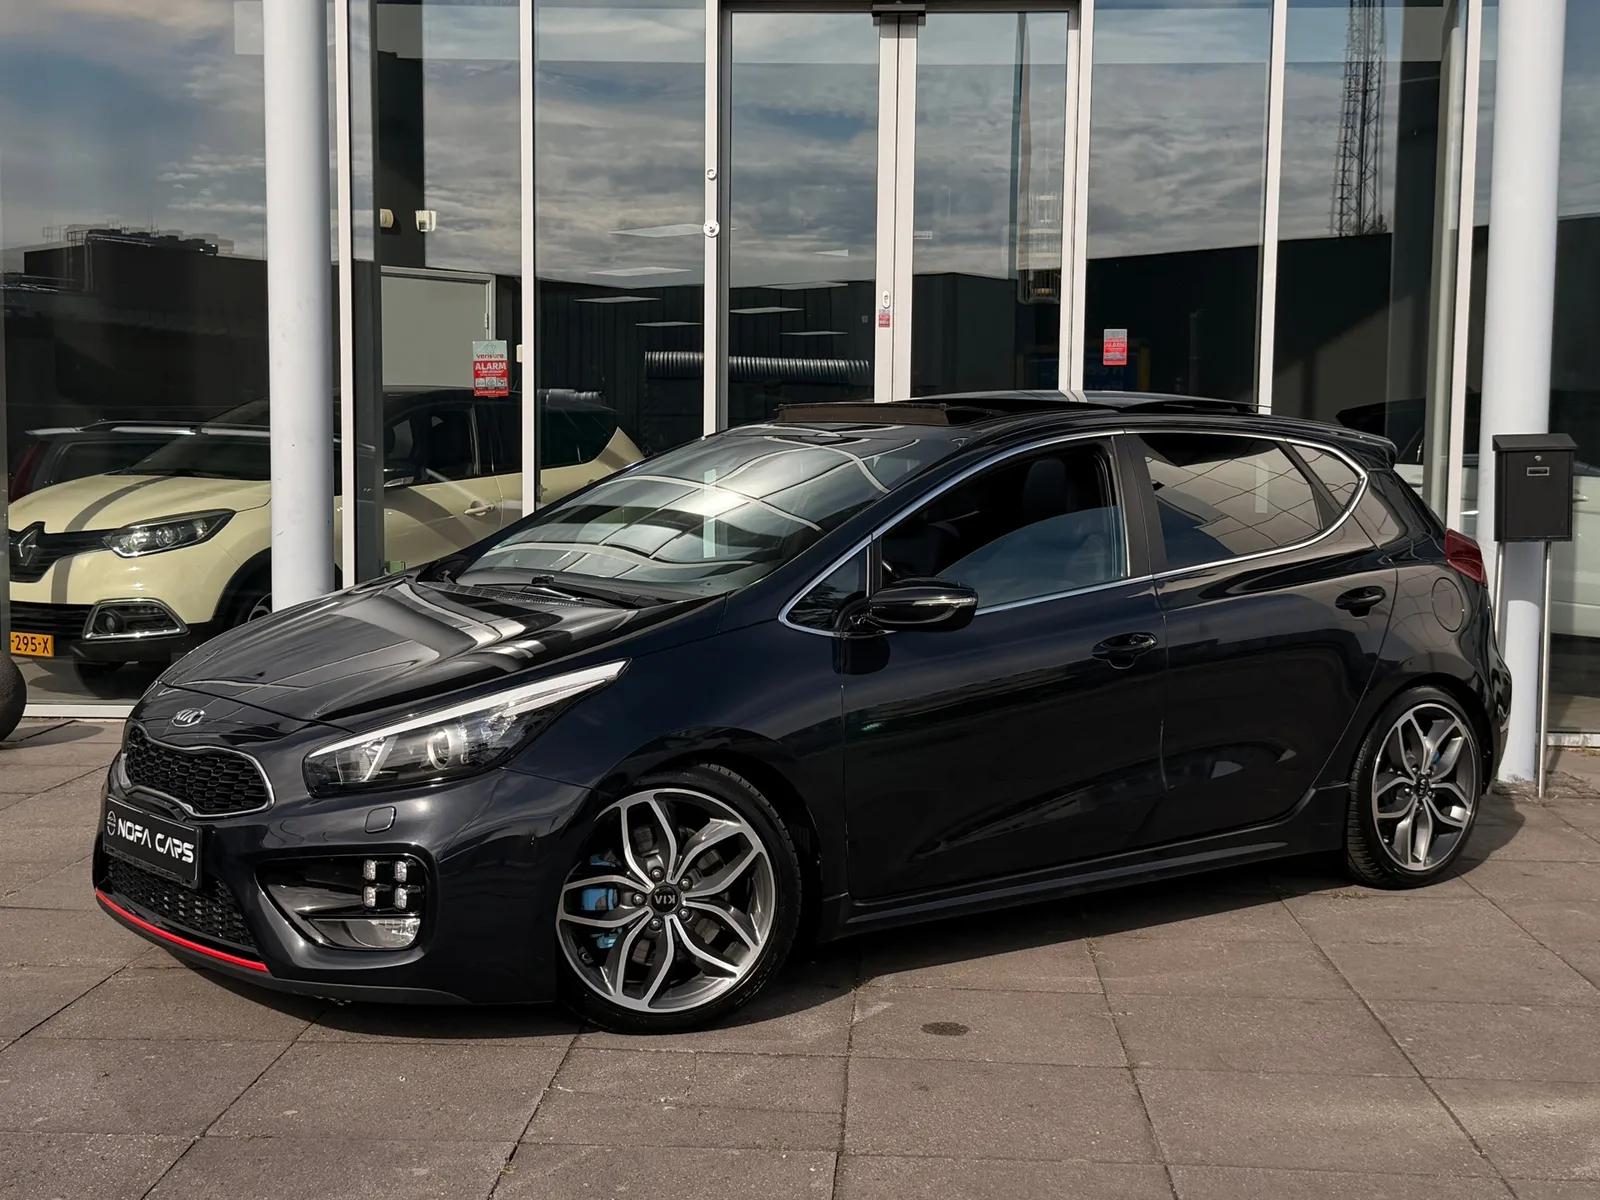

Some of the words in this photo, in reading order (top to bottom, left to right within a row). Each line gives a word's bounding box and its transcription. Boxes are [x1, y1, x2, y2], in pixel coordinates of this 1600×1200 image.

[475, 363, 507, 371] ALARM
[117, 818, 152, 849] NOFA
[654, 894, 676, 905] KIA
